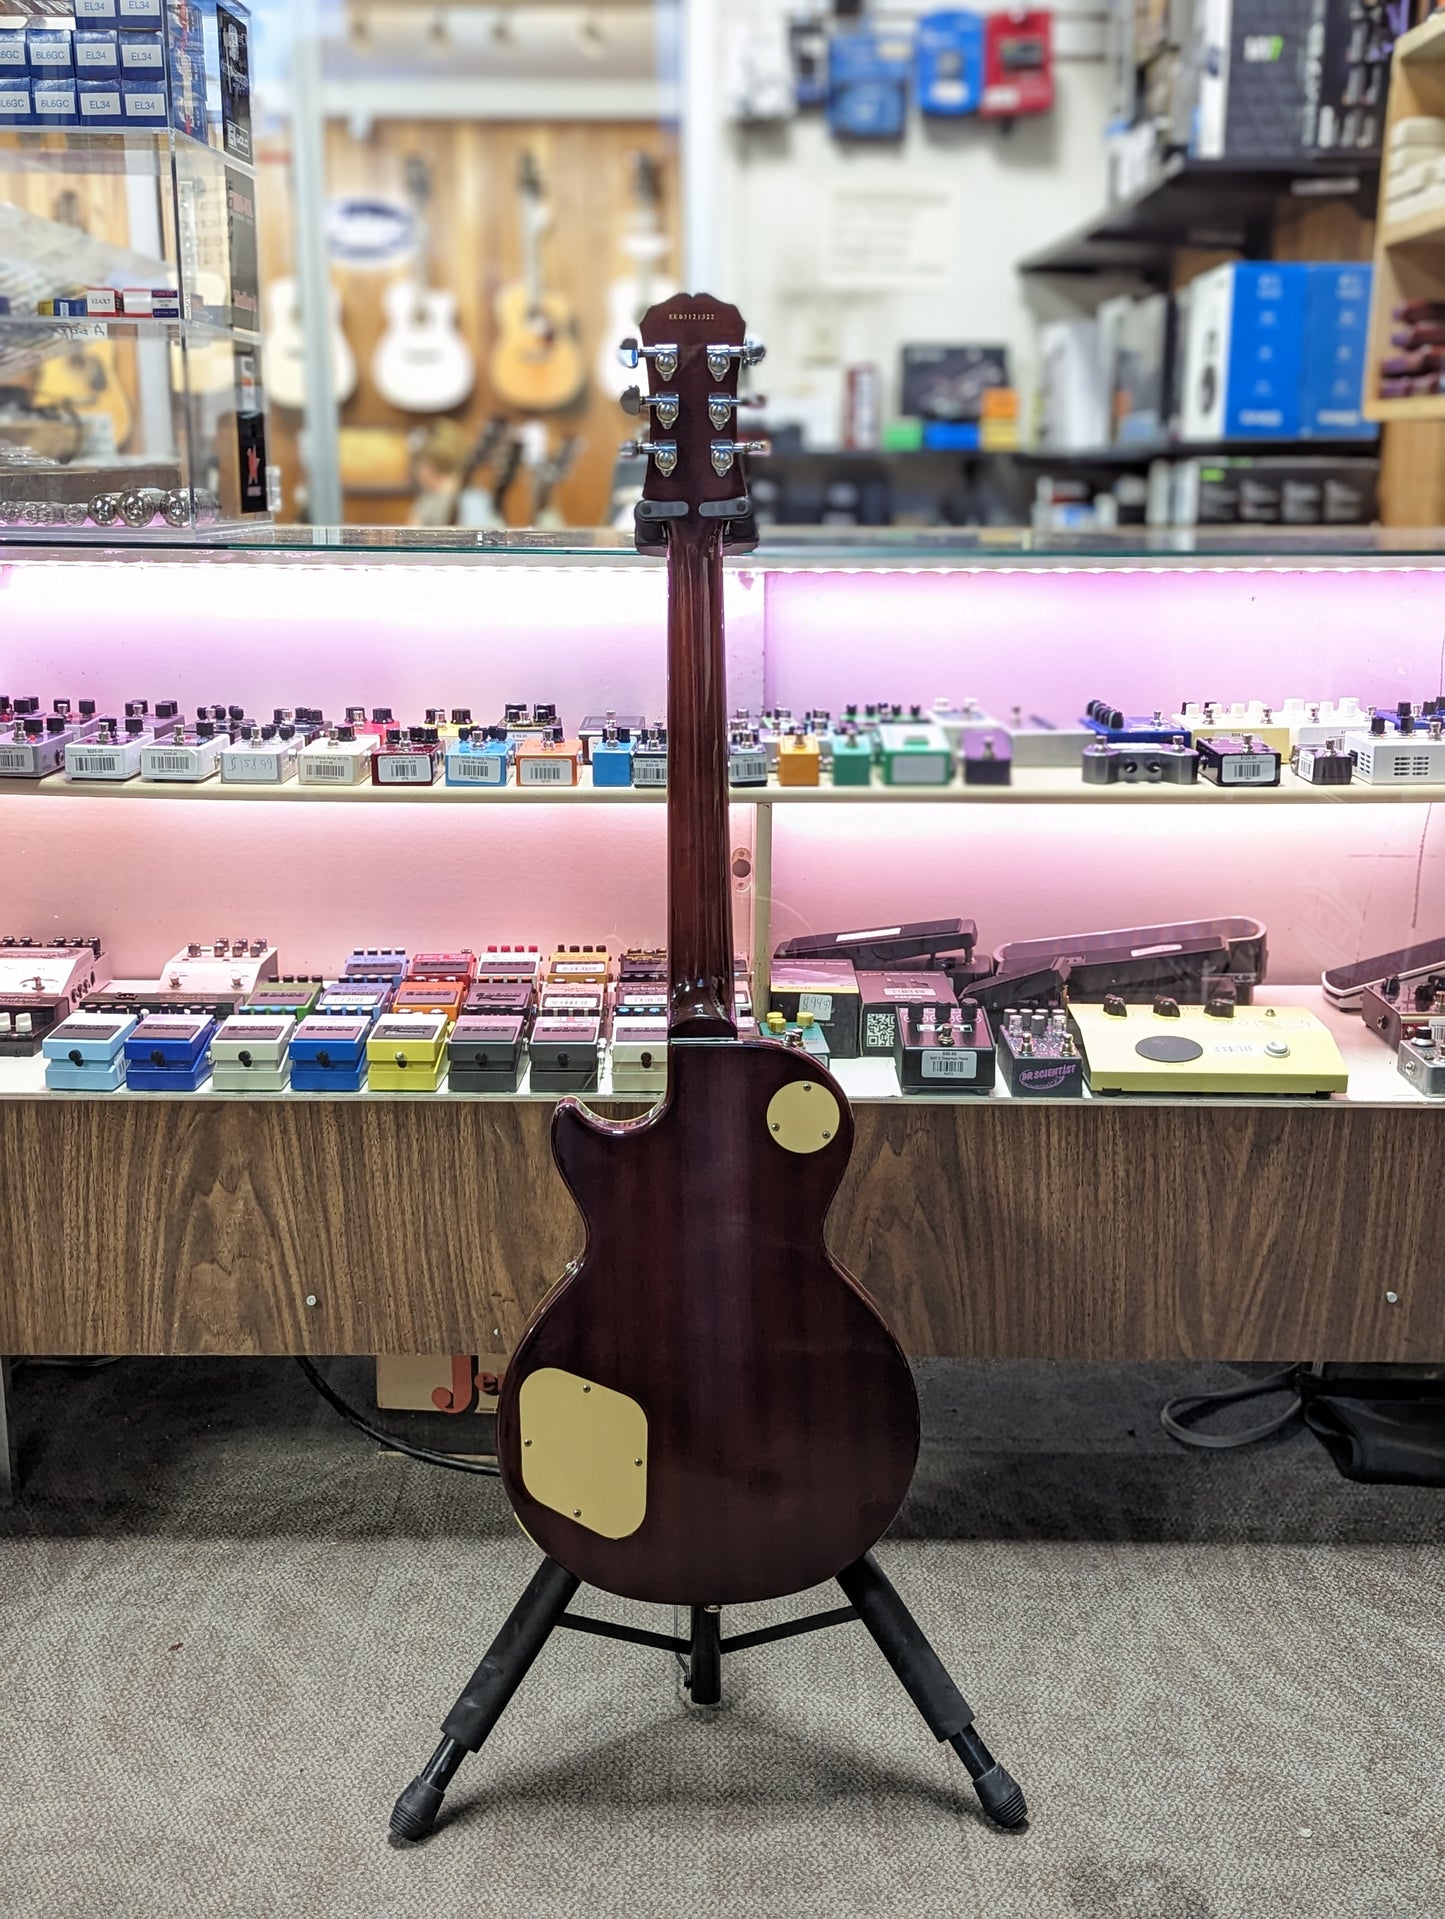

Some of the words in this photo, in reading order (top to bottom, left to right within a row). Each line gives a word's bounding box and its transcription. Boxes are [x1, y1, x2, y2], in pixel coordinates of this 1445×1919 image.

[84, 1, 105, 11] EL34
[128, 0, 150, 10] EL34
[36, 50, 65, 60] 6L6GC
[85, 50, 106, 60] EL34
[131, 52, 152, 61] EL34
[0, 99, 25, 108] L6GC
[41, 99, 70, 108] 6L6GC
[90, 99, 110, 109] EL34
[134, 101, 155, 111] EL34
